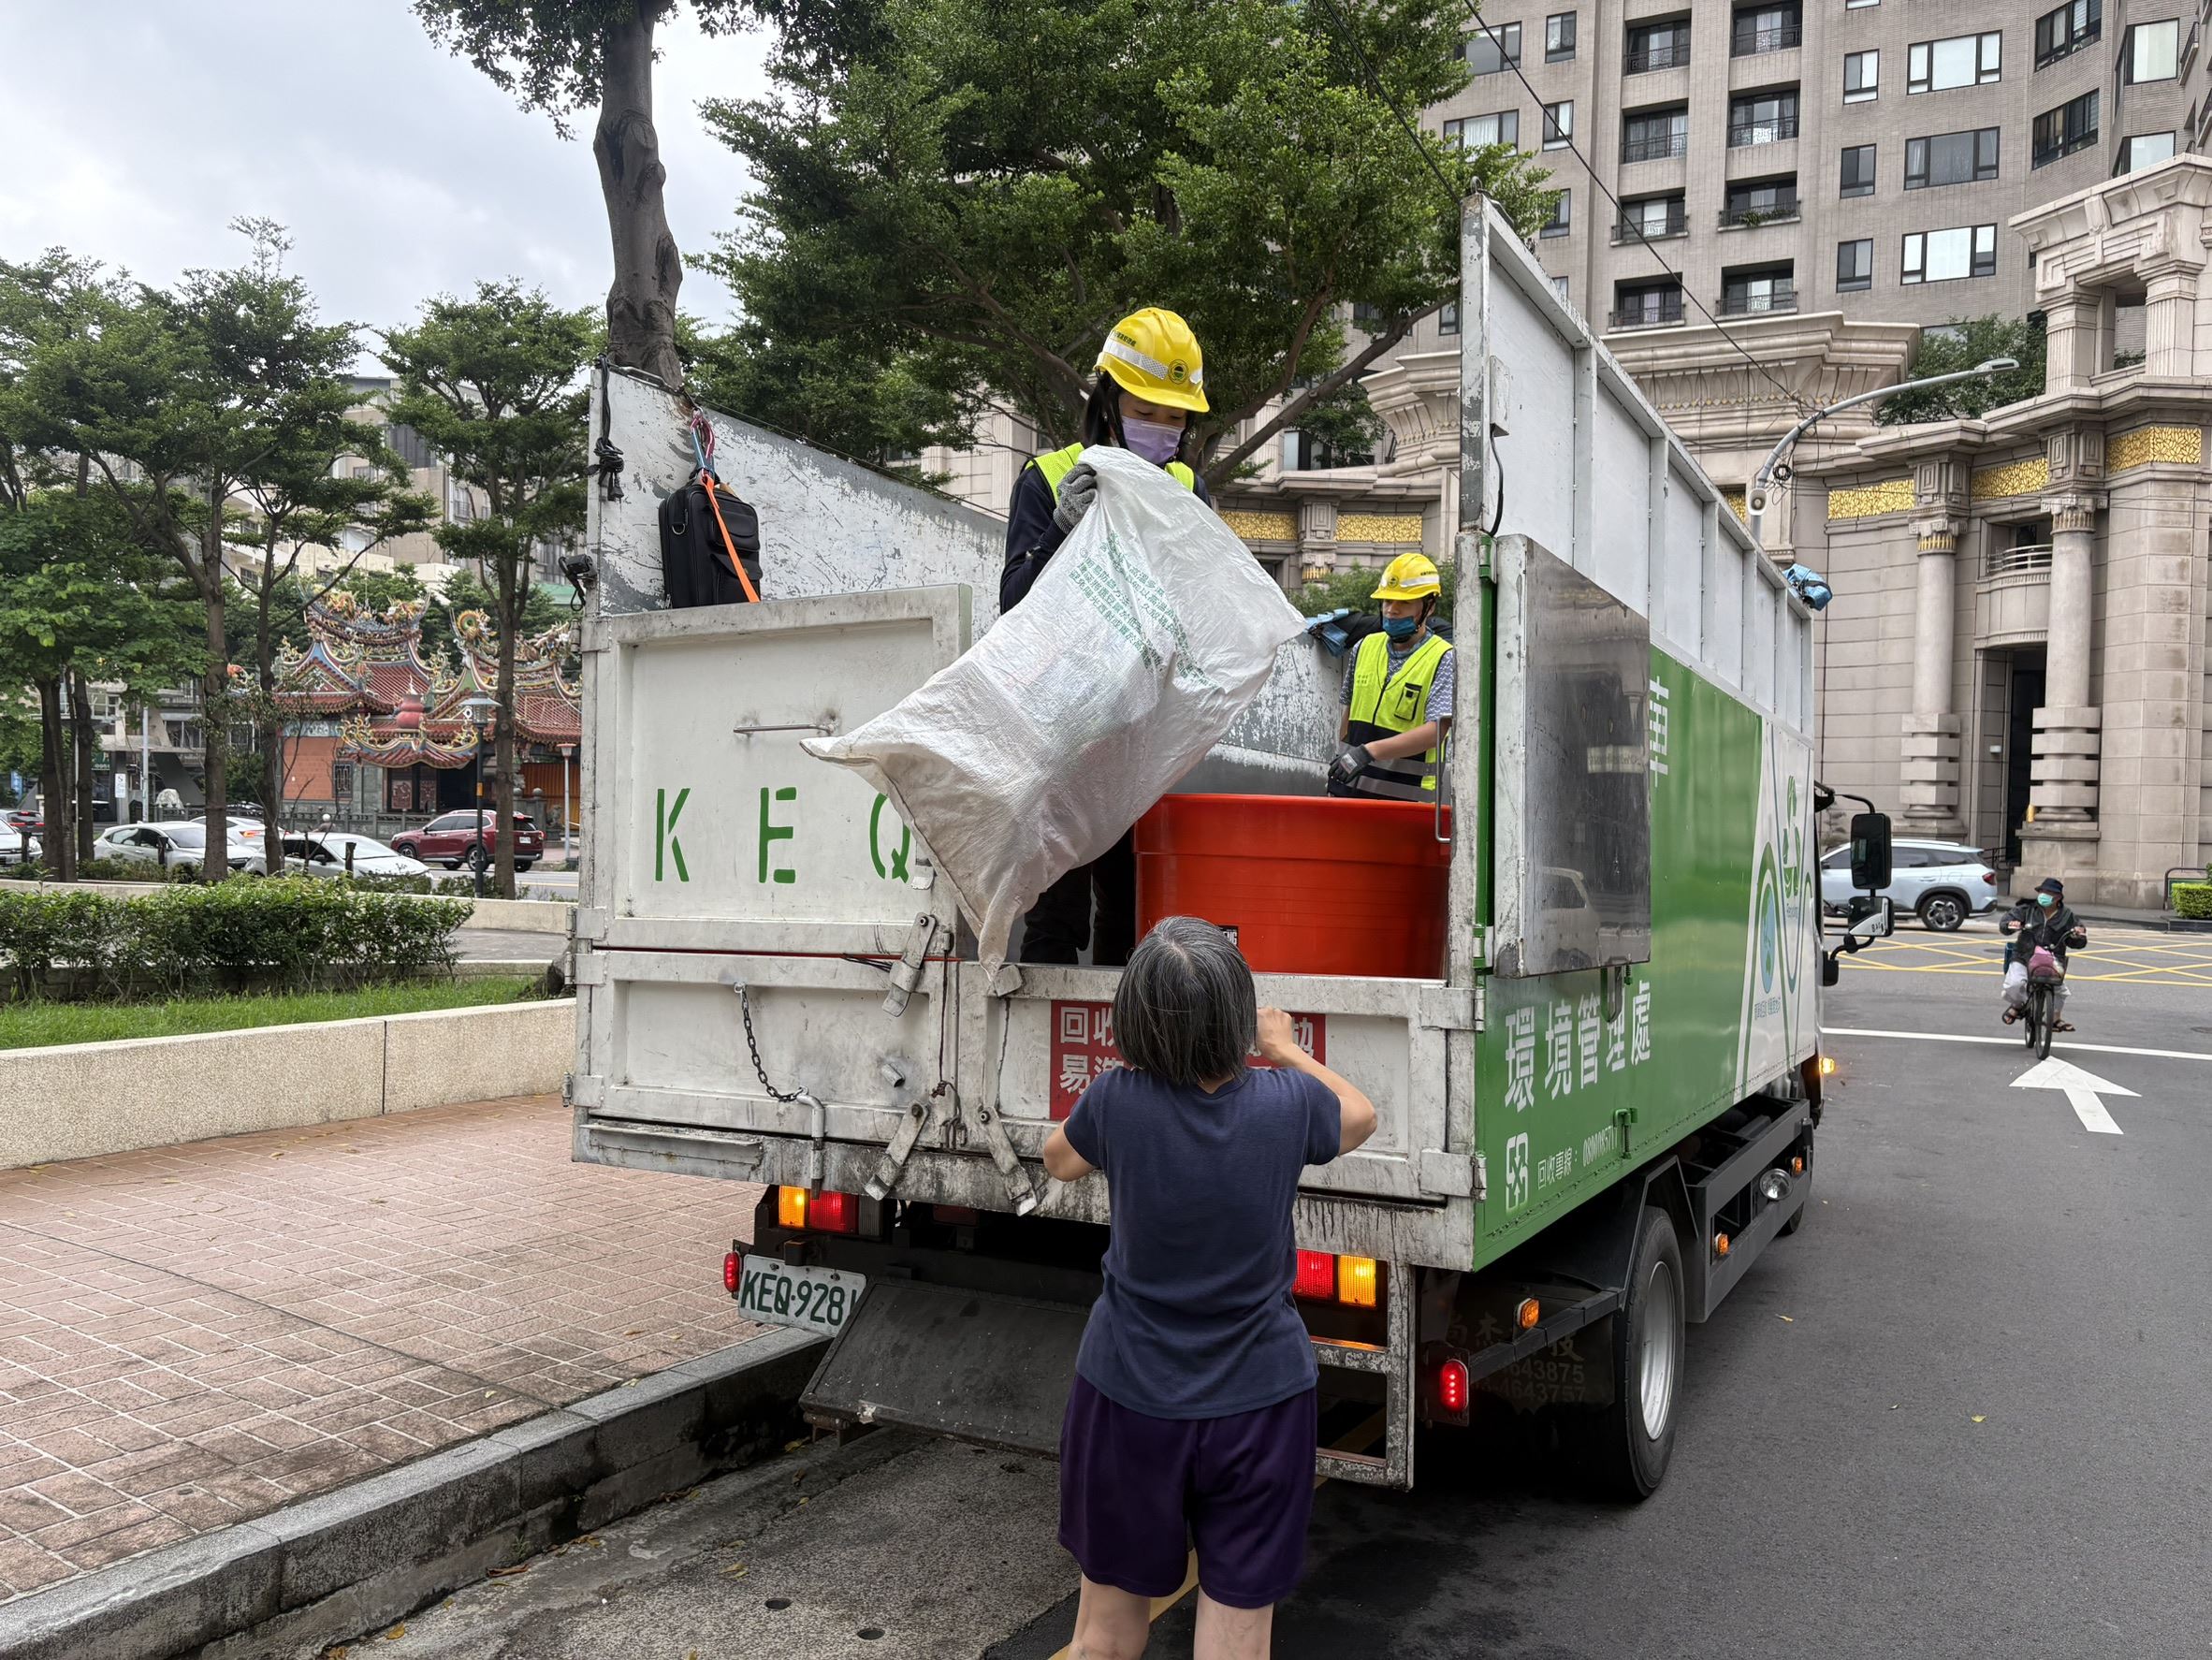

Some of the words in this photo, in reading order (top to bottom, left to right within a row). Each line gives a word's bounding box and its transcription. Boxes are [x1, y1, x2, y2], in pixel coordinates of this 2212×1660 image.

[1504, 980, 1652, 1113] 環境管理處
